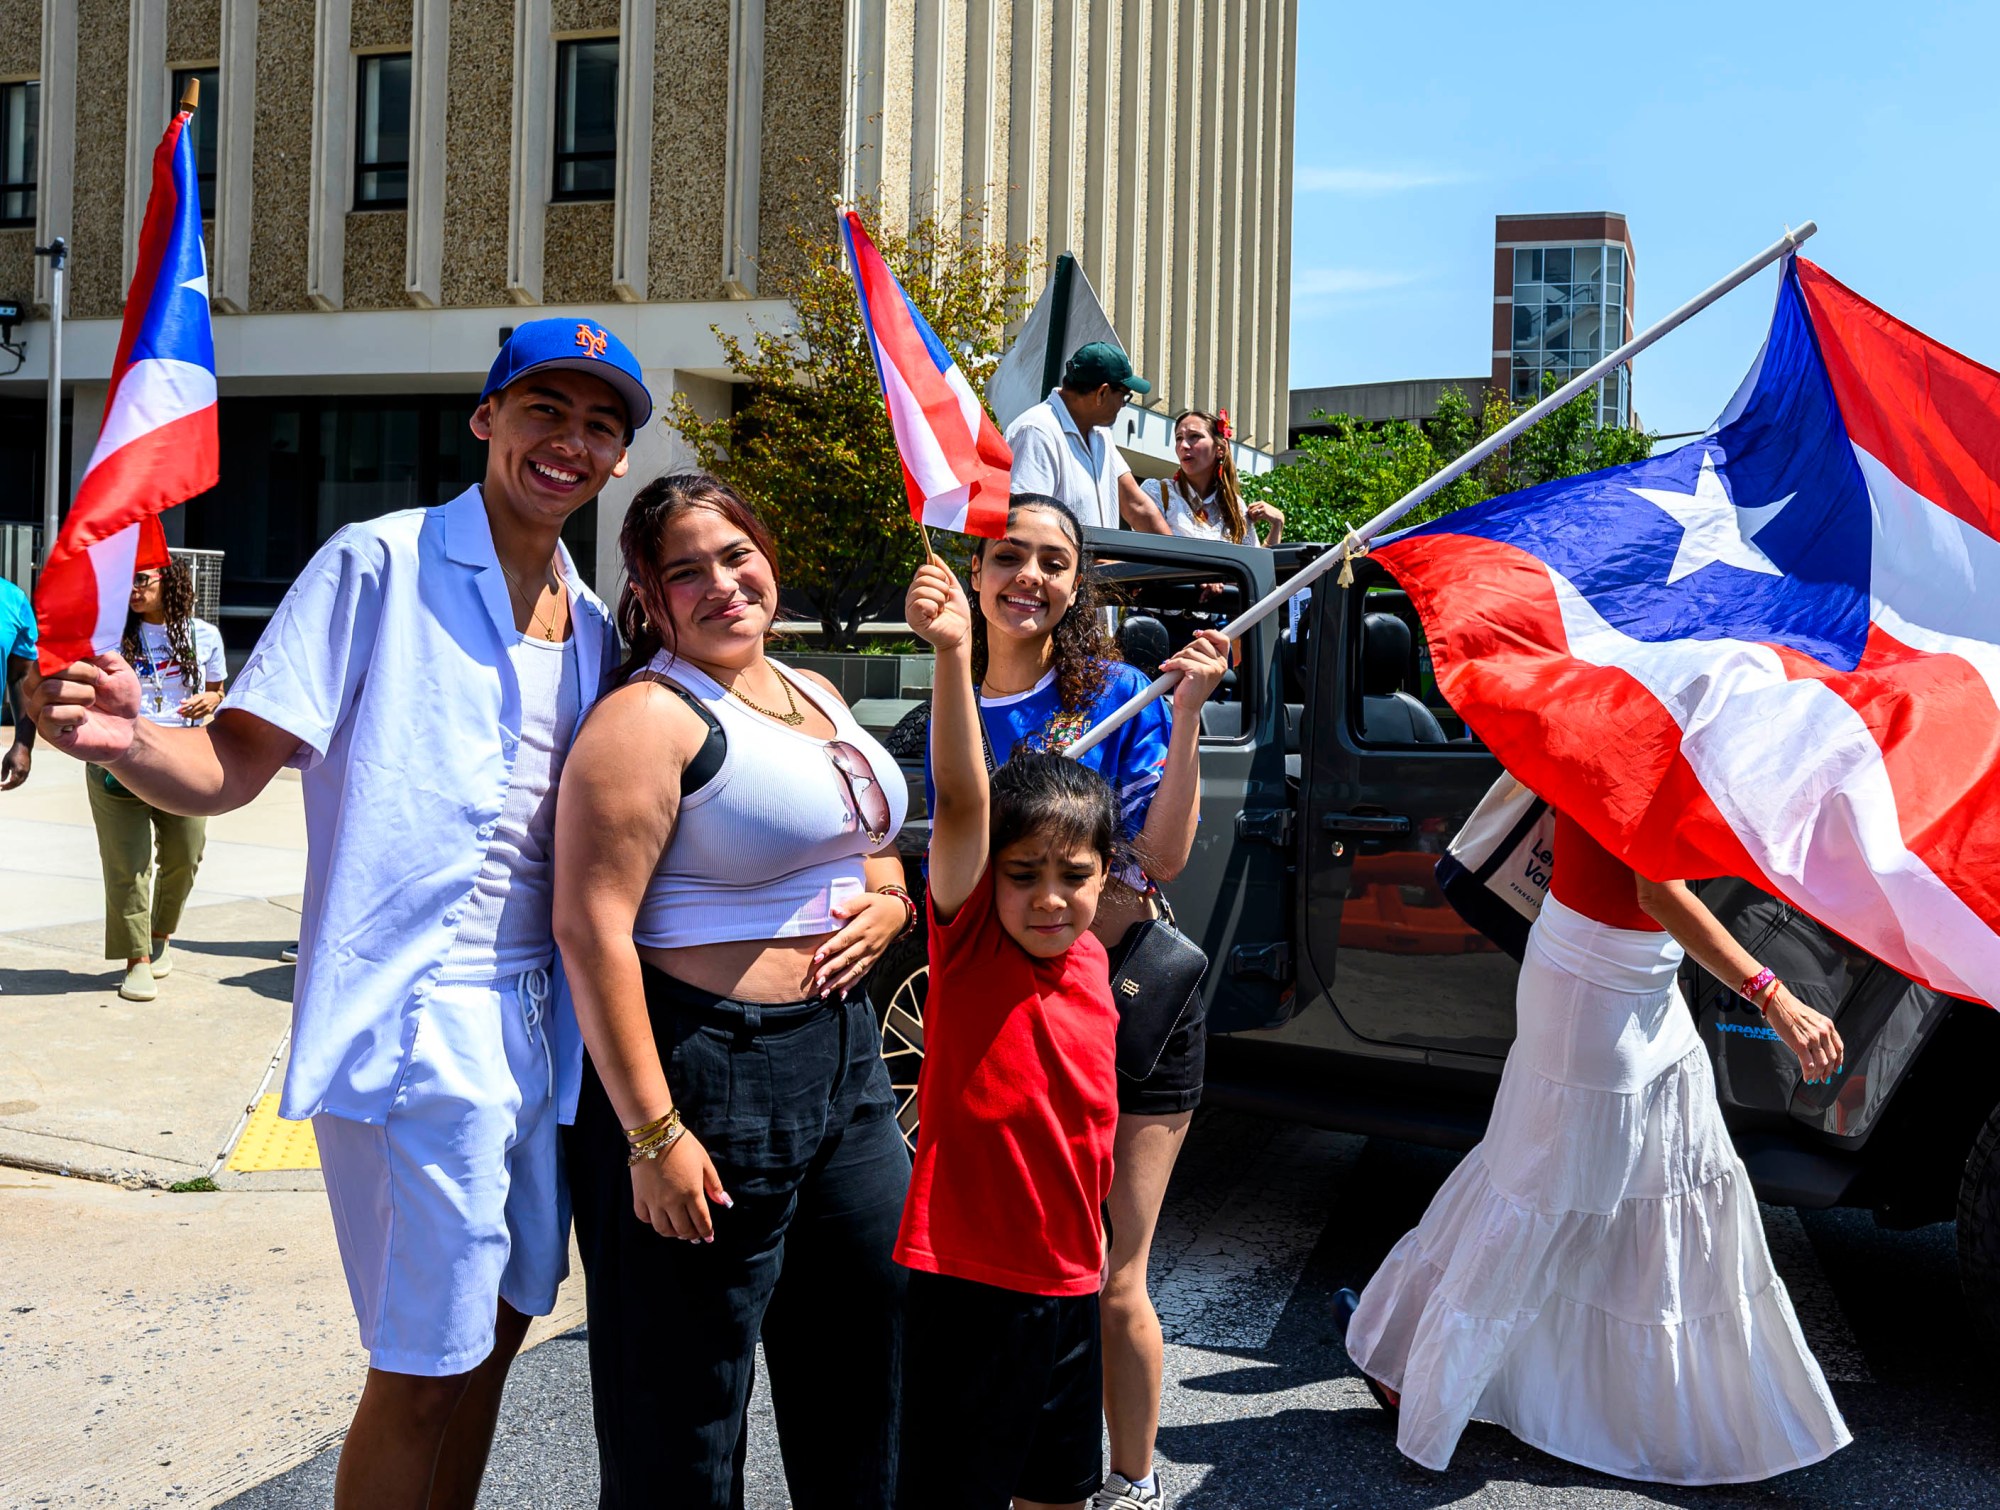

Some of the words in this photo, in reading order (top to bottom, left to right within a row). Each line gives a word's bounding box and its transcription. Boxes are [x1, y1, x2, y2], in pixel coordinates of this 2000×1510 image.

[575, 323, 608, 359] NY
[1531, 837, 1555, 868] Le
[1524, 858, 1552, 894] Val
[1510, 881, 1543, 909] PENNSYLV
[1714, 1022, 1780, 1037] WRANG
[1743, 1032, 1784, 1042] UNLIM
